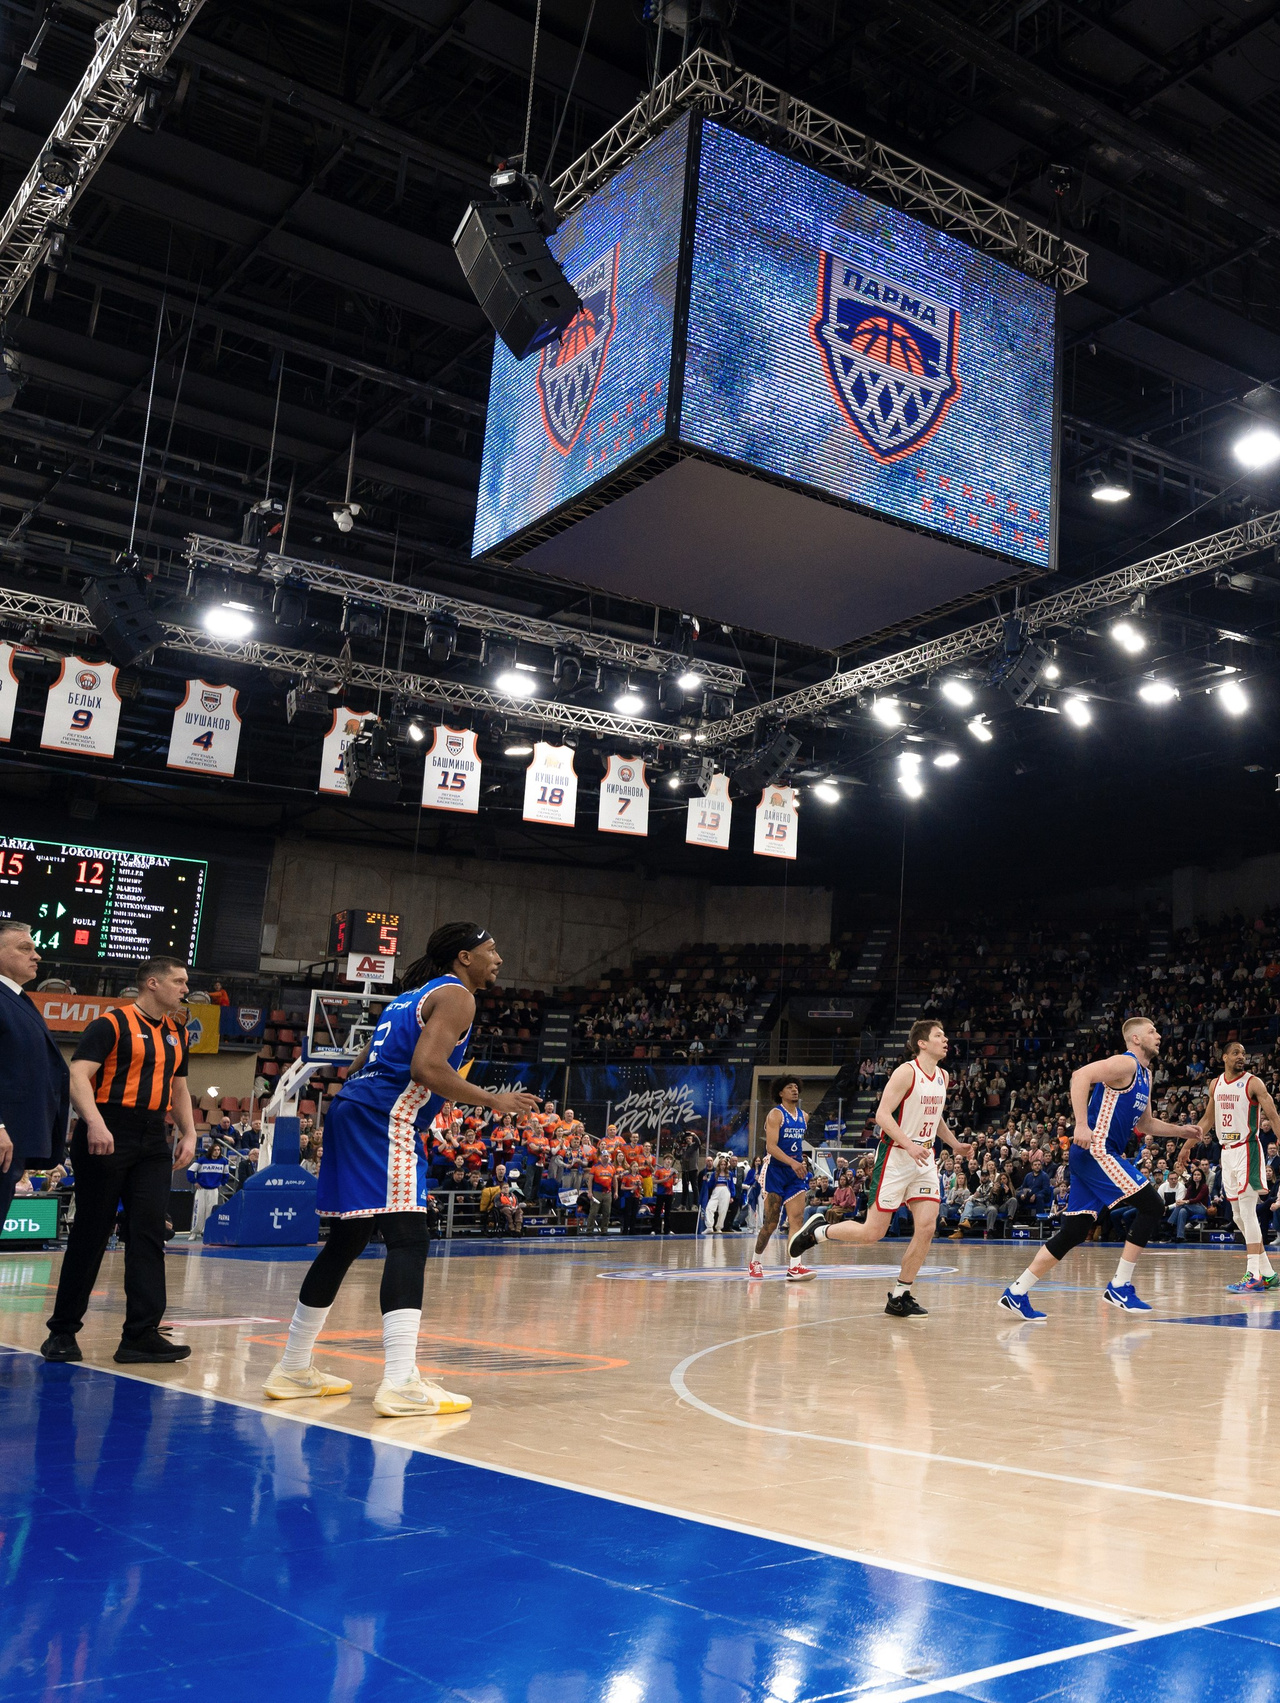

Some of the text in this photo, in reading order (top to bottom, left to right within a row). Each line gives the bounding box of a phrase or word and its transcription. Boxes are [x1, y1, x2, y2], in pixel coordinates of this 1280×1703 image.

[843, 266, 937, 326] ПАРМА
[68, 692, 102, 709] БЕЛЫХ
[70, 709, 94, 731] 9
[185, 712, 230, 731] ШУШАКОВ
[192, 731, 215, 751] 4
[432, 756, 475, 772] БАШМИНОВ
[437, 771, 467, 792] 15
[535, 772, 569, 787] КУЩЕНКО
[536, 786, 565, 807] 18
[606, 783, 644, 798] КИРЬЯНОВА
[617, 797, 631, 816] 7
[764, 809, 791, 823] ДАЙНЕКО
[697, 810, 721, 831] 13
[765, 822, 788, 842] 15
[61, 845, 172, 867] LOKOMOTIV-KUBAN
[76, 861, 104, 885] 12
[116, 884, 143, 893] MARTIN
[38, 904, 48, 918] 5
[72, 917, 97, 926] FOULS
[378, 925, 398, 955] 5
[614, 1083, 694, 1111] PARMA
[1217, 1094, 1240, 1102] LOKOMOTIV
[1220, 1102, 1235, 1110] KUBAN
[613, 1100, 702, 1136] POWER
[1222, 1114, 1233, 1127] 32
[919, 1122, 934, 1138] 33
[790, 1141, 798, 1152] 6
